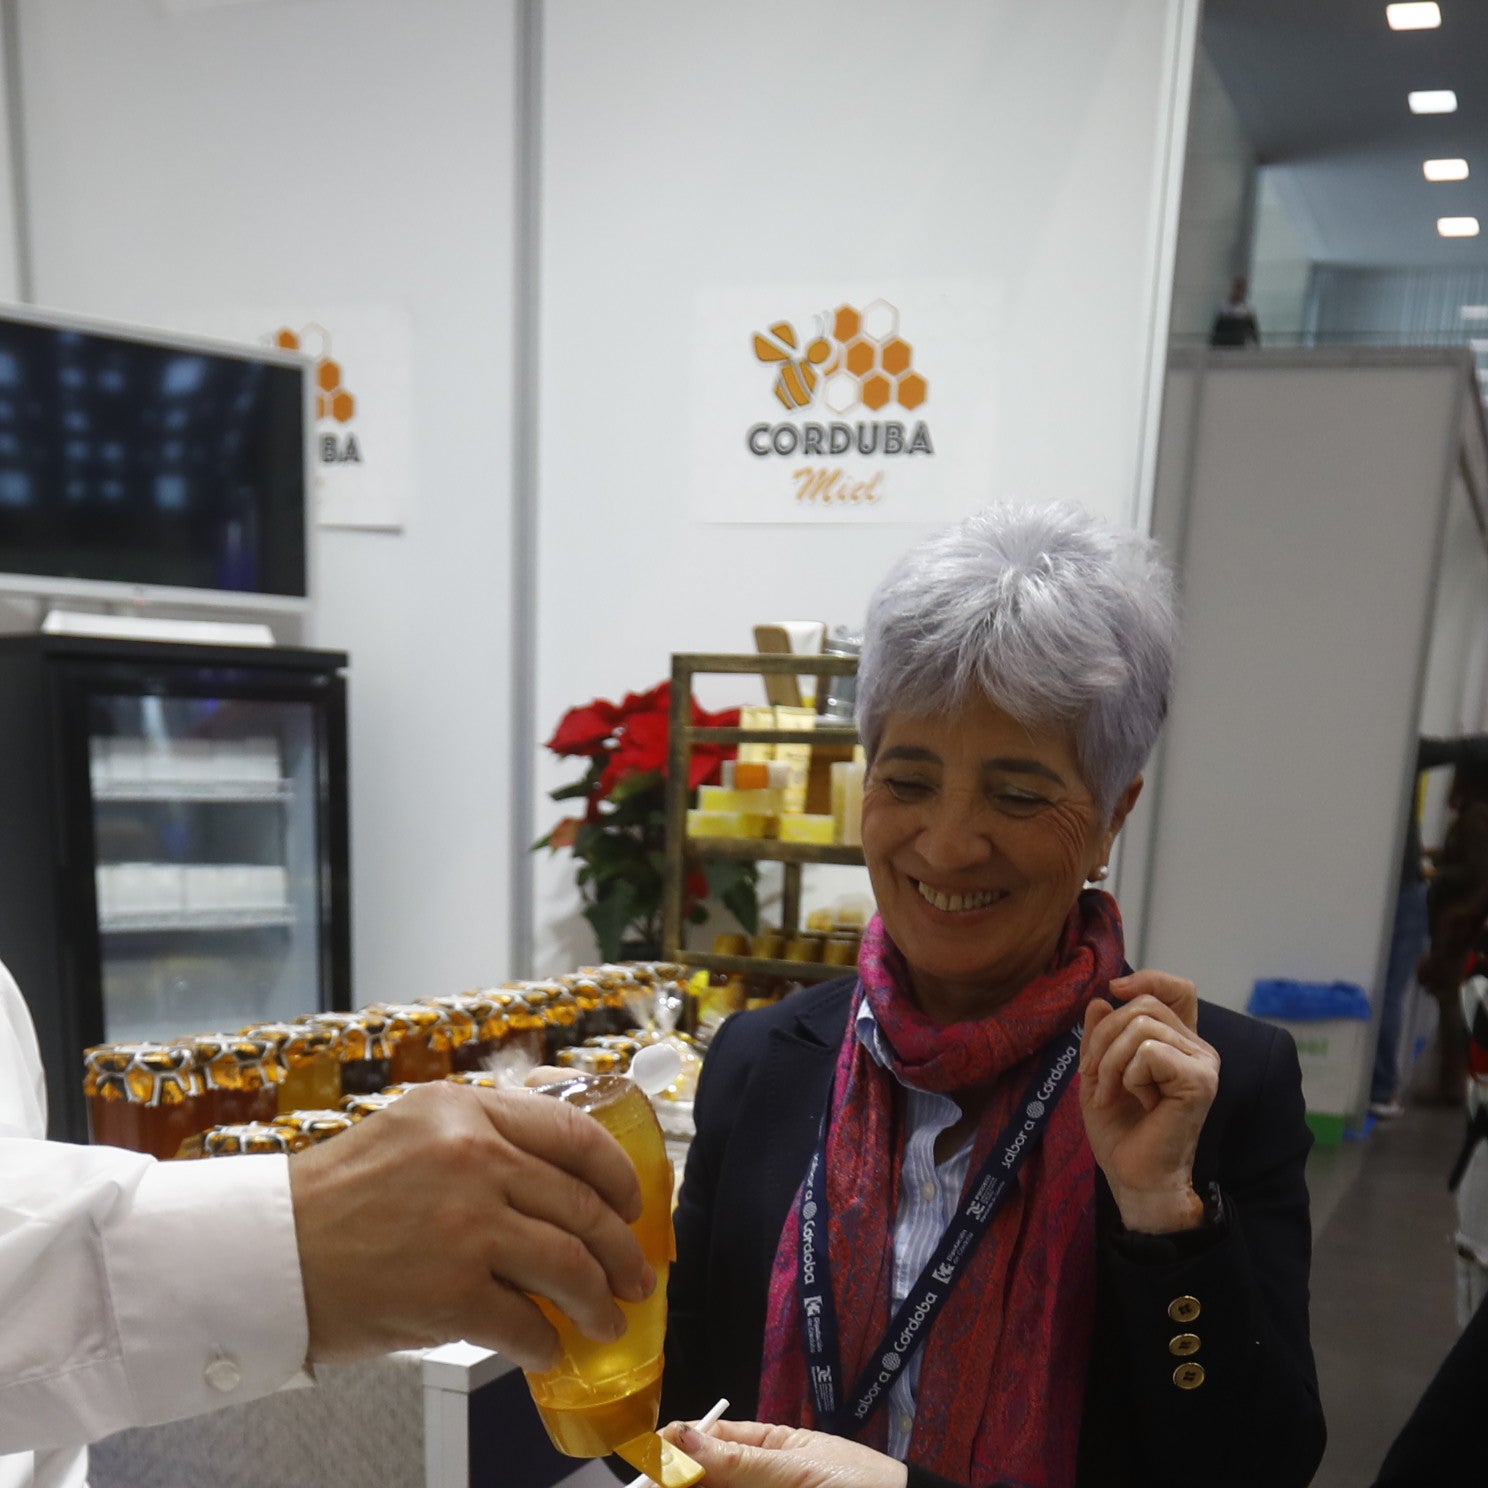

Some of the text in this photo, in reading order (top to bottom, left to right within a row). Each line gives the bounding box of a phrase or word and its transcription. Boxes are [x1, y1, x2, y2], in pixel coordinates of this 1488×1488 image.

[747, 423, 935, 455] CORDUBA
[793, 467, 884, 502] Miel
[1001, 1046, 1077, 1169] sabor a Córdoba
[805, 1189, 813, 1201] a
[803, 1220, 817, 1285] Córdoba
[855, 1292, 938, 1419] sabor a Córdoba
